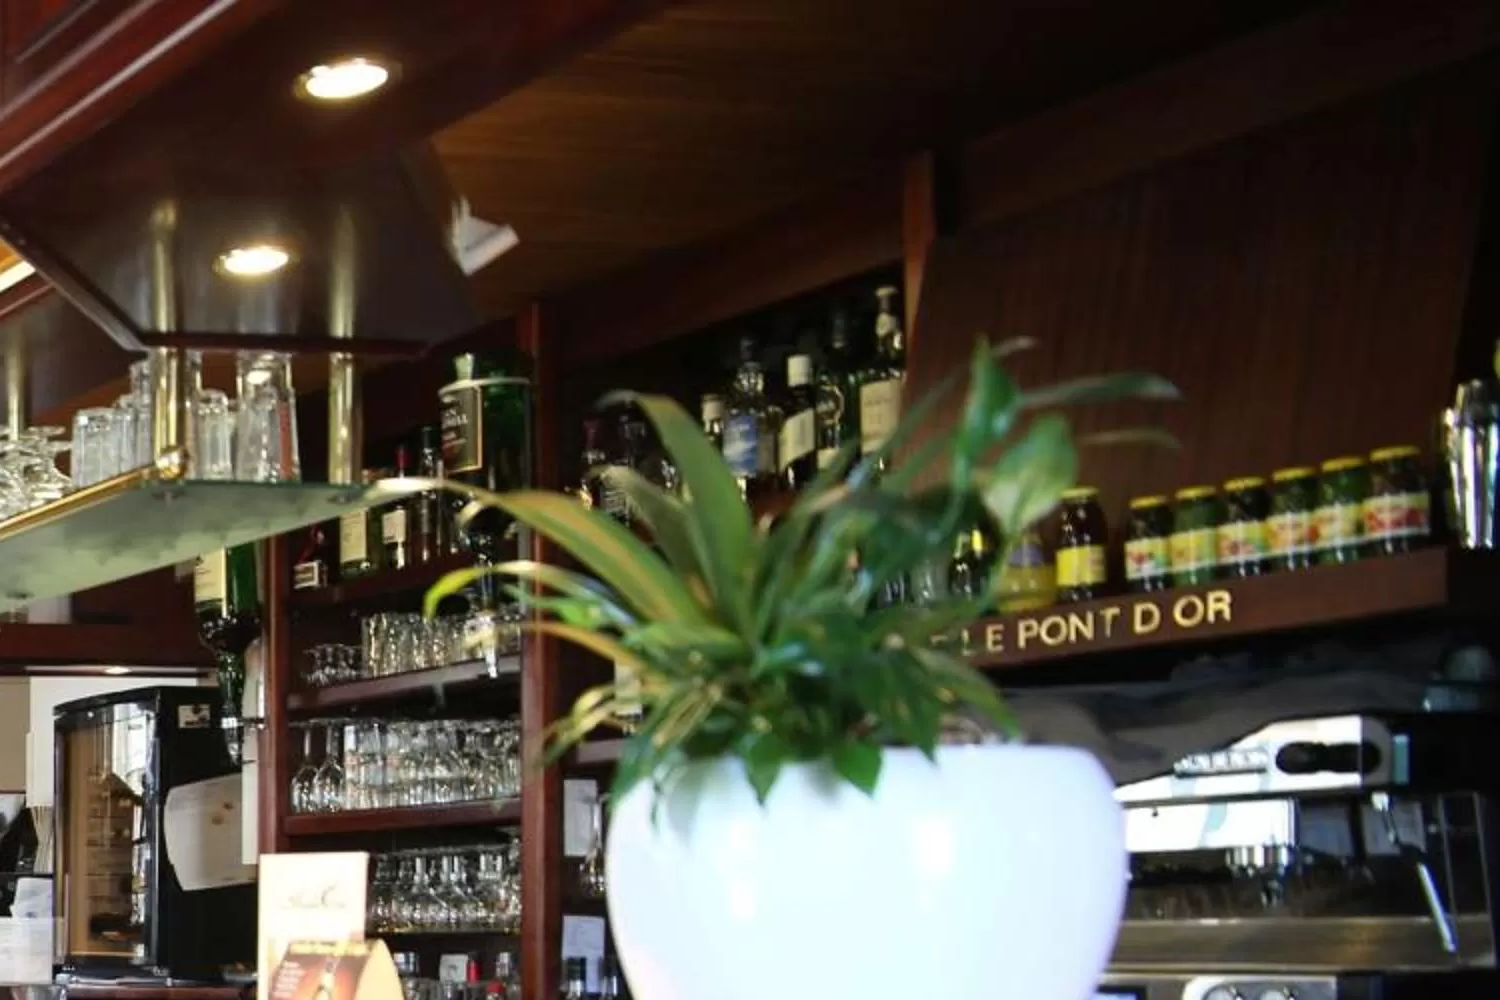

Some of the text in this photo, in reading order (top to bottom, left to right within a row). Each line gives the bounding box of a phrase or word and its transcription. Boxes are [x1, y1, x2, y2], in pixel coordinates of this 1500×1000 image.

[961, 624, 1004, 657] LE
[1016, 606, 1121, 650] PONT
[1172, 589, 1232, 629] OR
